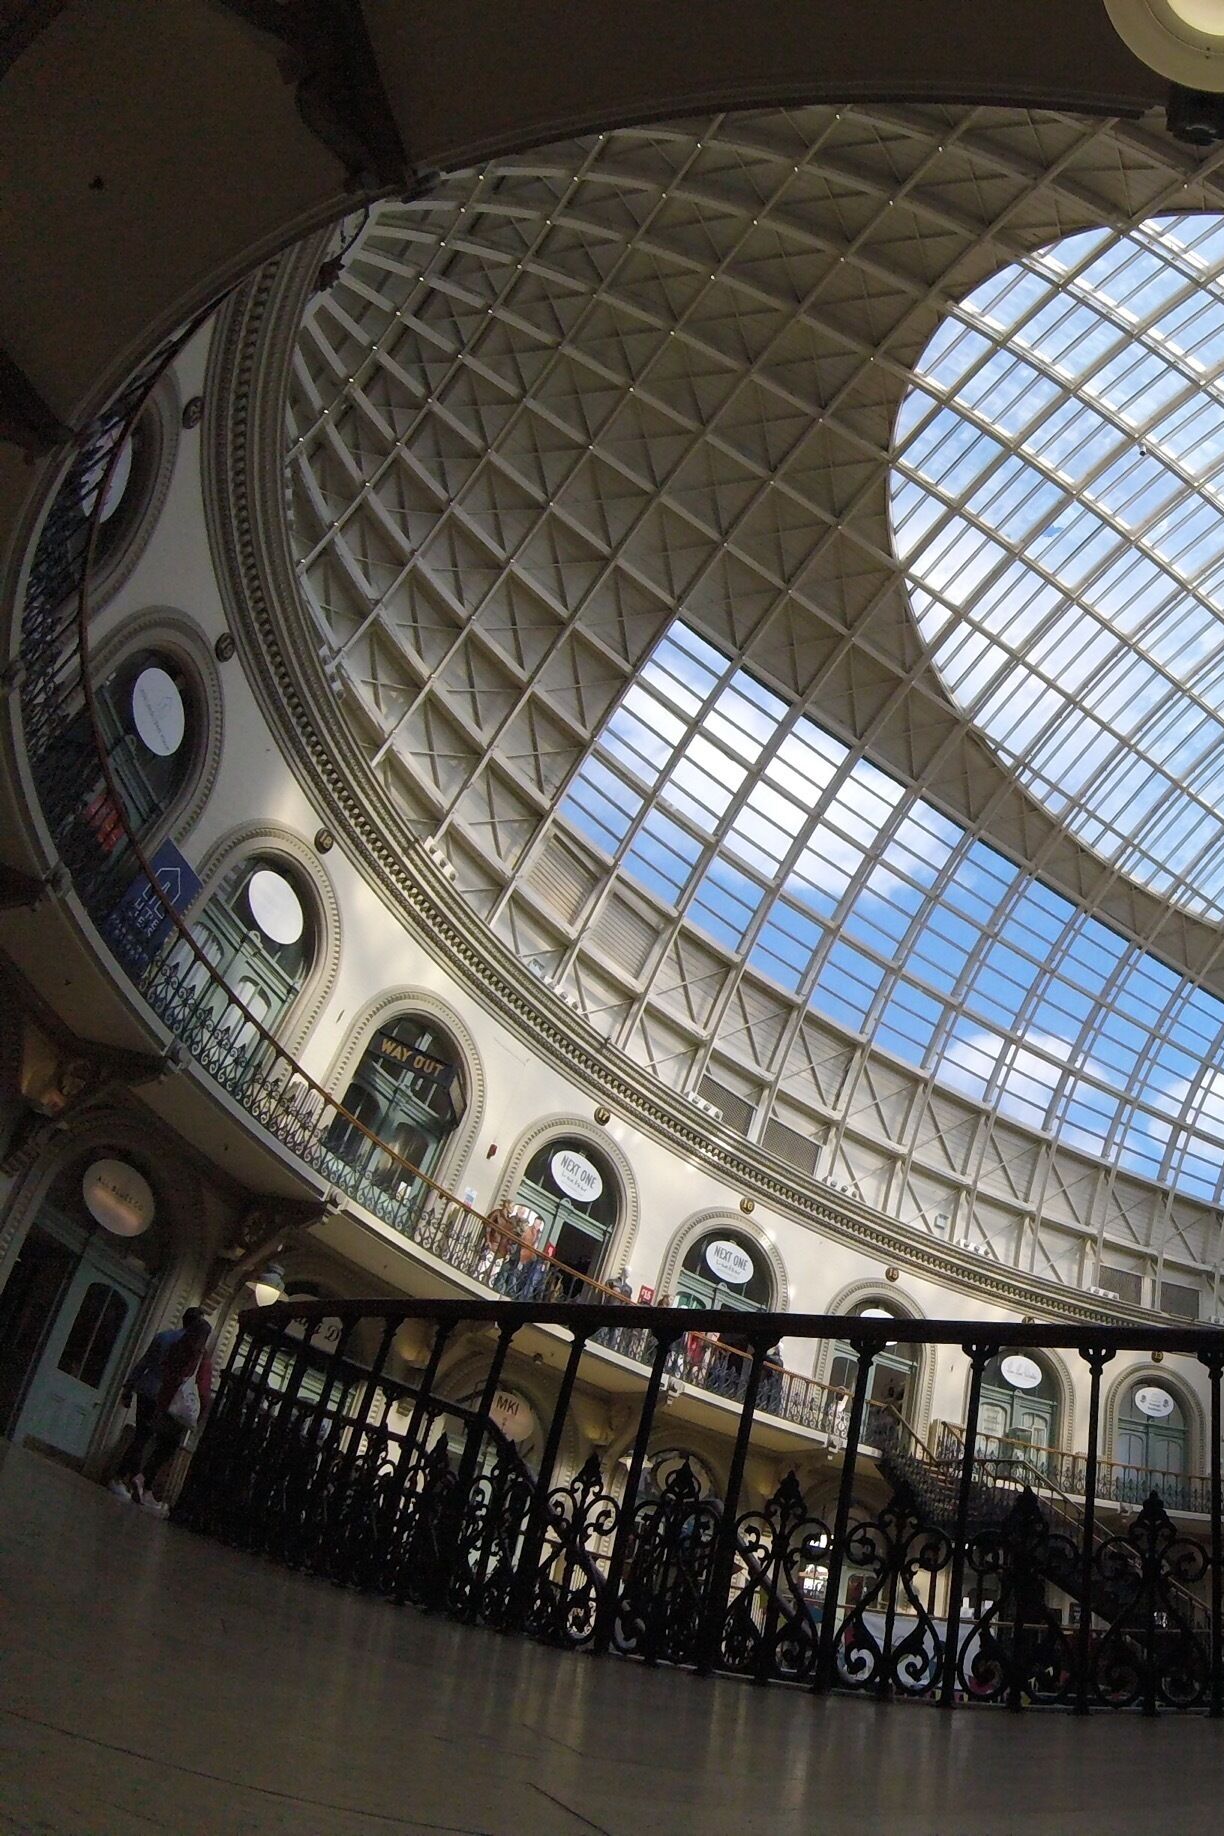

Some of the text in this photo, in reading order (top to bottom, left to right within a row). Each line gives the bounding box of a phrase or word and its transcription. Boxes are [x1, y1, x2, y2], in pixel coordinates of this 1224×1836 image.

[319, 830, 333, 849] 18
[381, 1038, 446, 1077] WAY OUT
[598, 1108, 609, 1121] 17
[560, 1155, 581, 1177] NEXT
[580, 1169, 597, 1189] ONE
[742, 1198, 754, 1210] 16
[714, 1244, 749, 1272] NEXT ONE
[888, 1267, 899, 1279] 15
[496, 1395, 520, 1416] MKI
